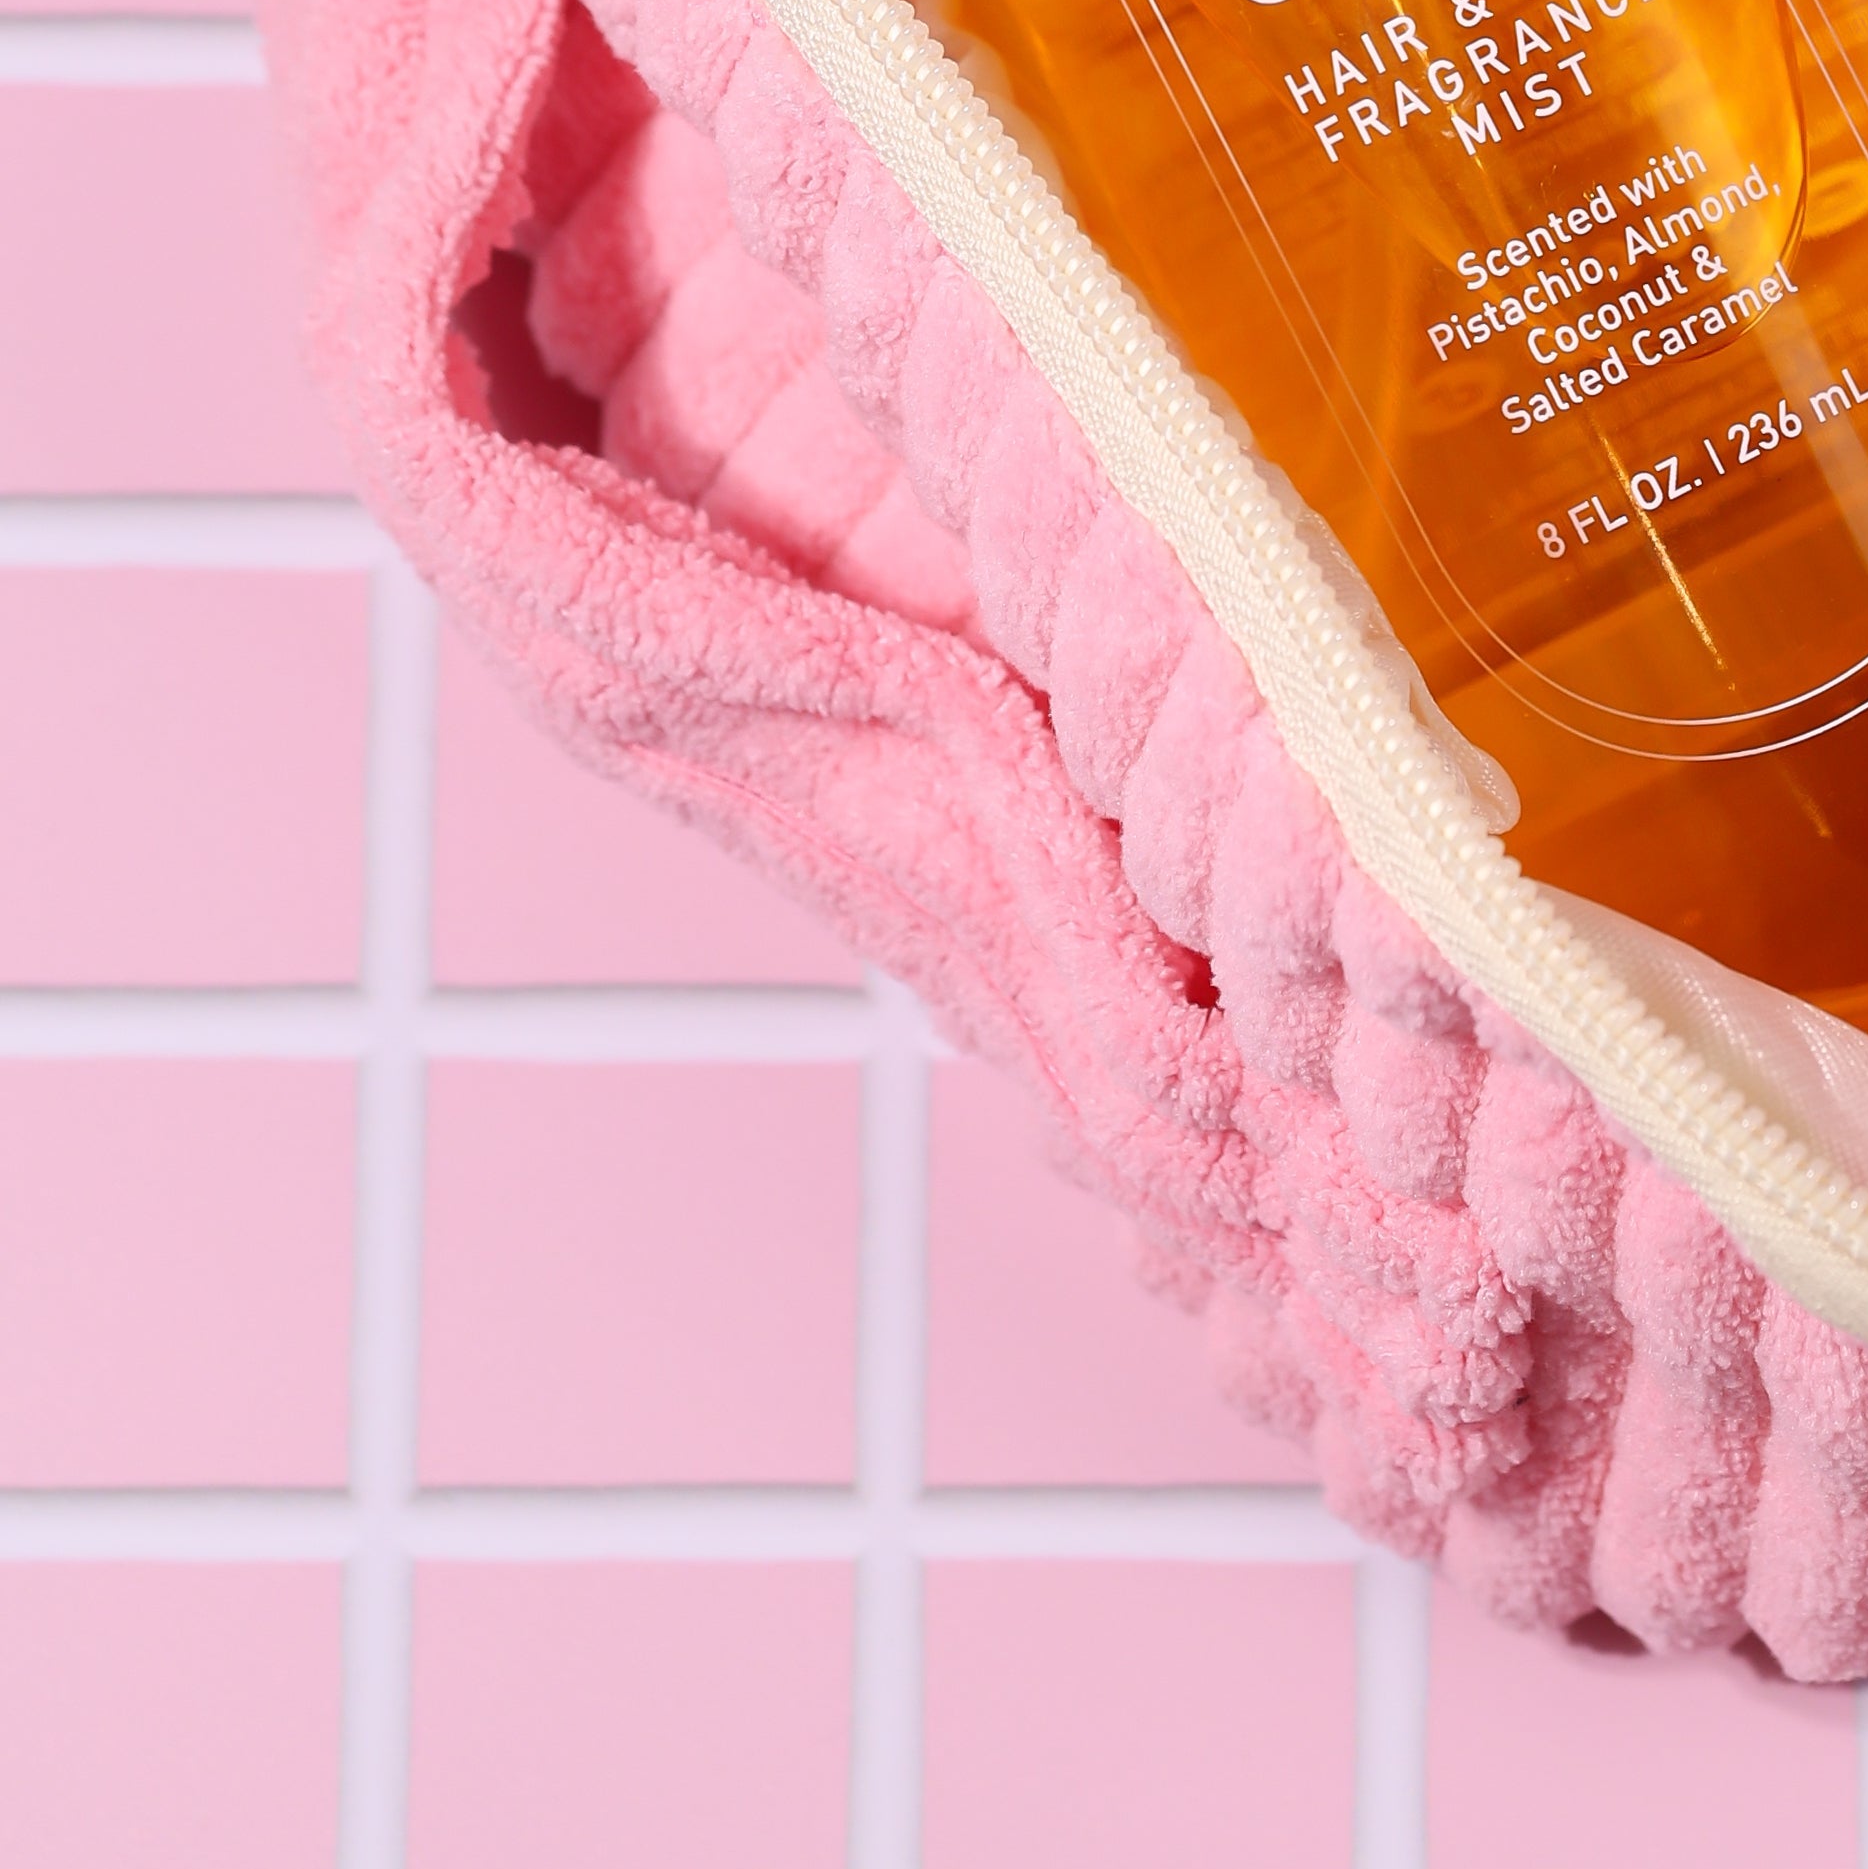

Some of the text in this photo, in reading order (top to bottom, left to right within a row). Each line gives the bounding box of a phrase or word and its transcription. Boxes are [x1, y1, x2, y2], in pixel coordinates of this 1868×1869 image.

[1284, 16, 1427, 114] HAIR
[1450, 53, 1598, 156] MIST
[1426, 164, 1781, 362] Pistachio, Almond,
[1457, 146, 1707, 290] Scented with
[1501, 261, 1799, 434] Salted Caramel
[1526, 245, 1727, 366] Coconut &
[1537, 522, 1566, 559] 8
[1567, 495, 1628, 544] FL
[1630, 456, 1703, 510] OZ.
[1728, 399, 1802, 463] 236
